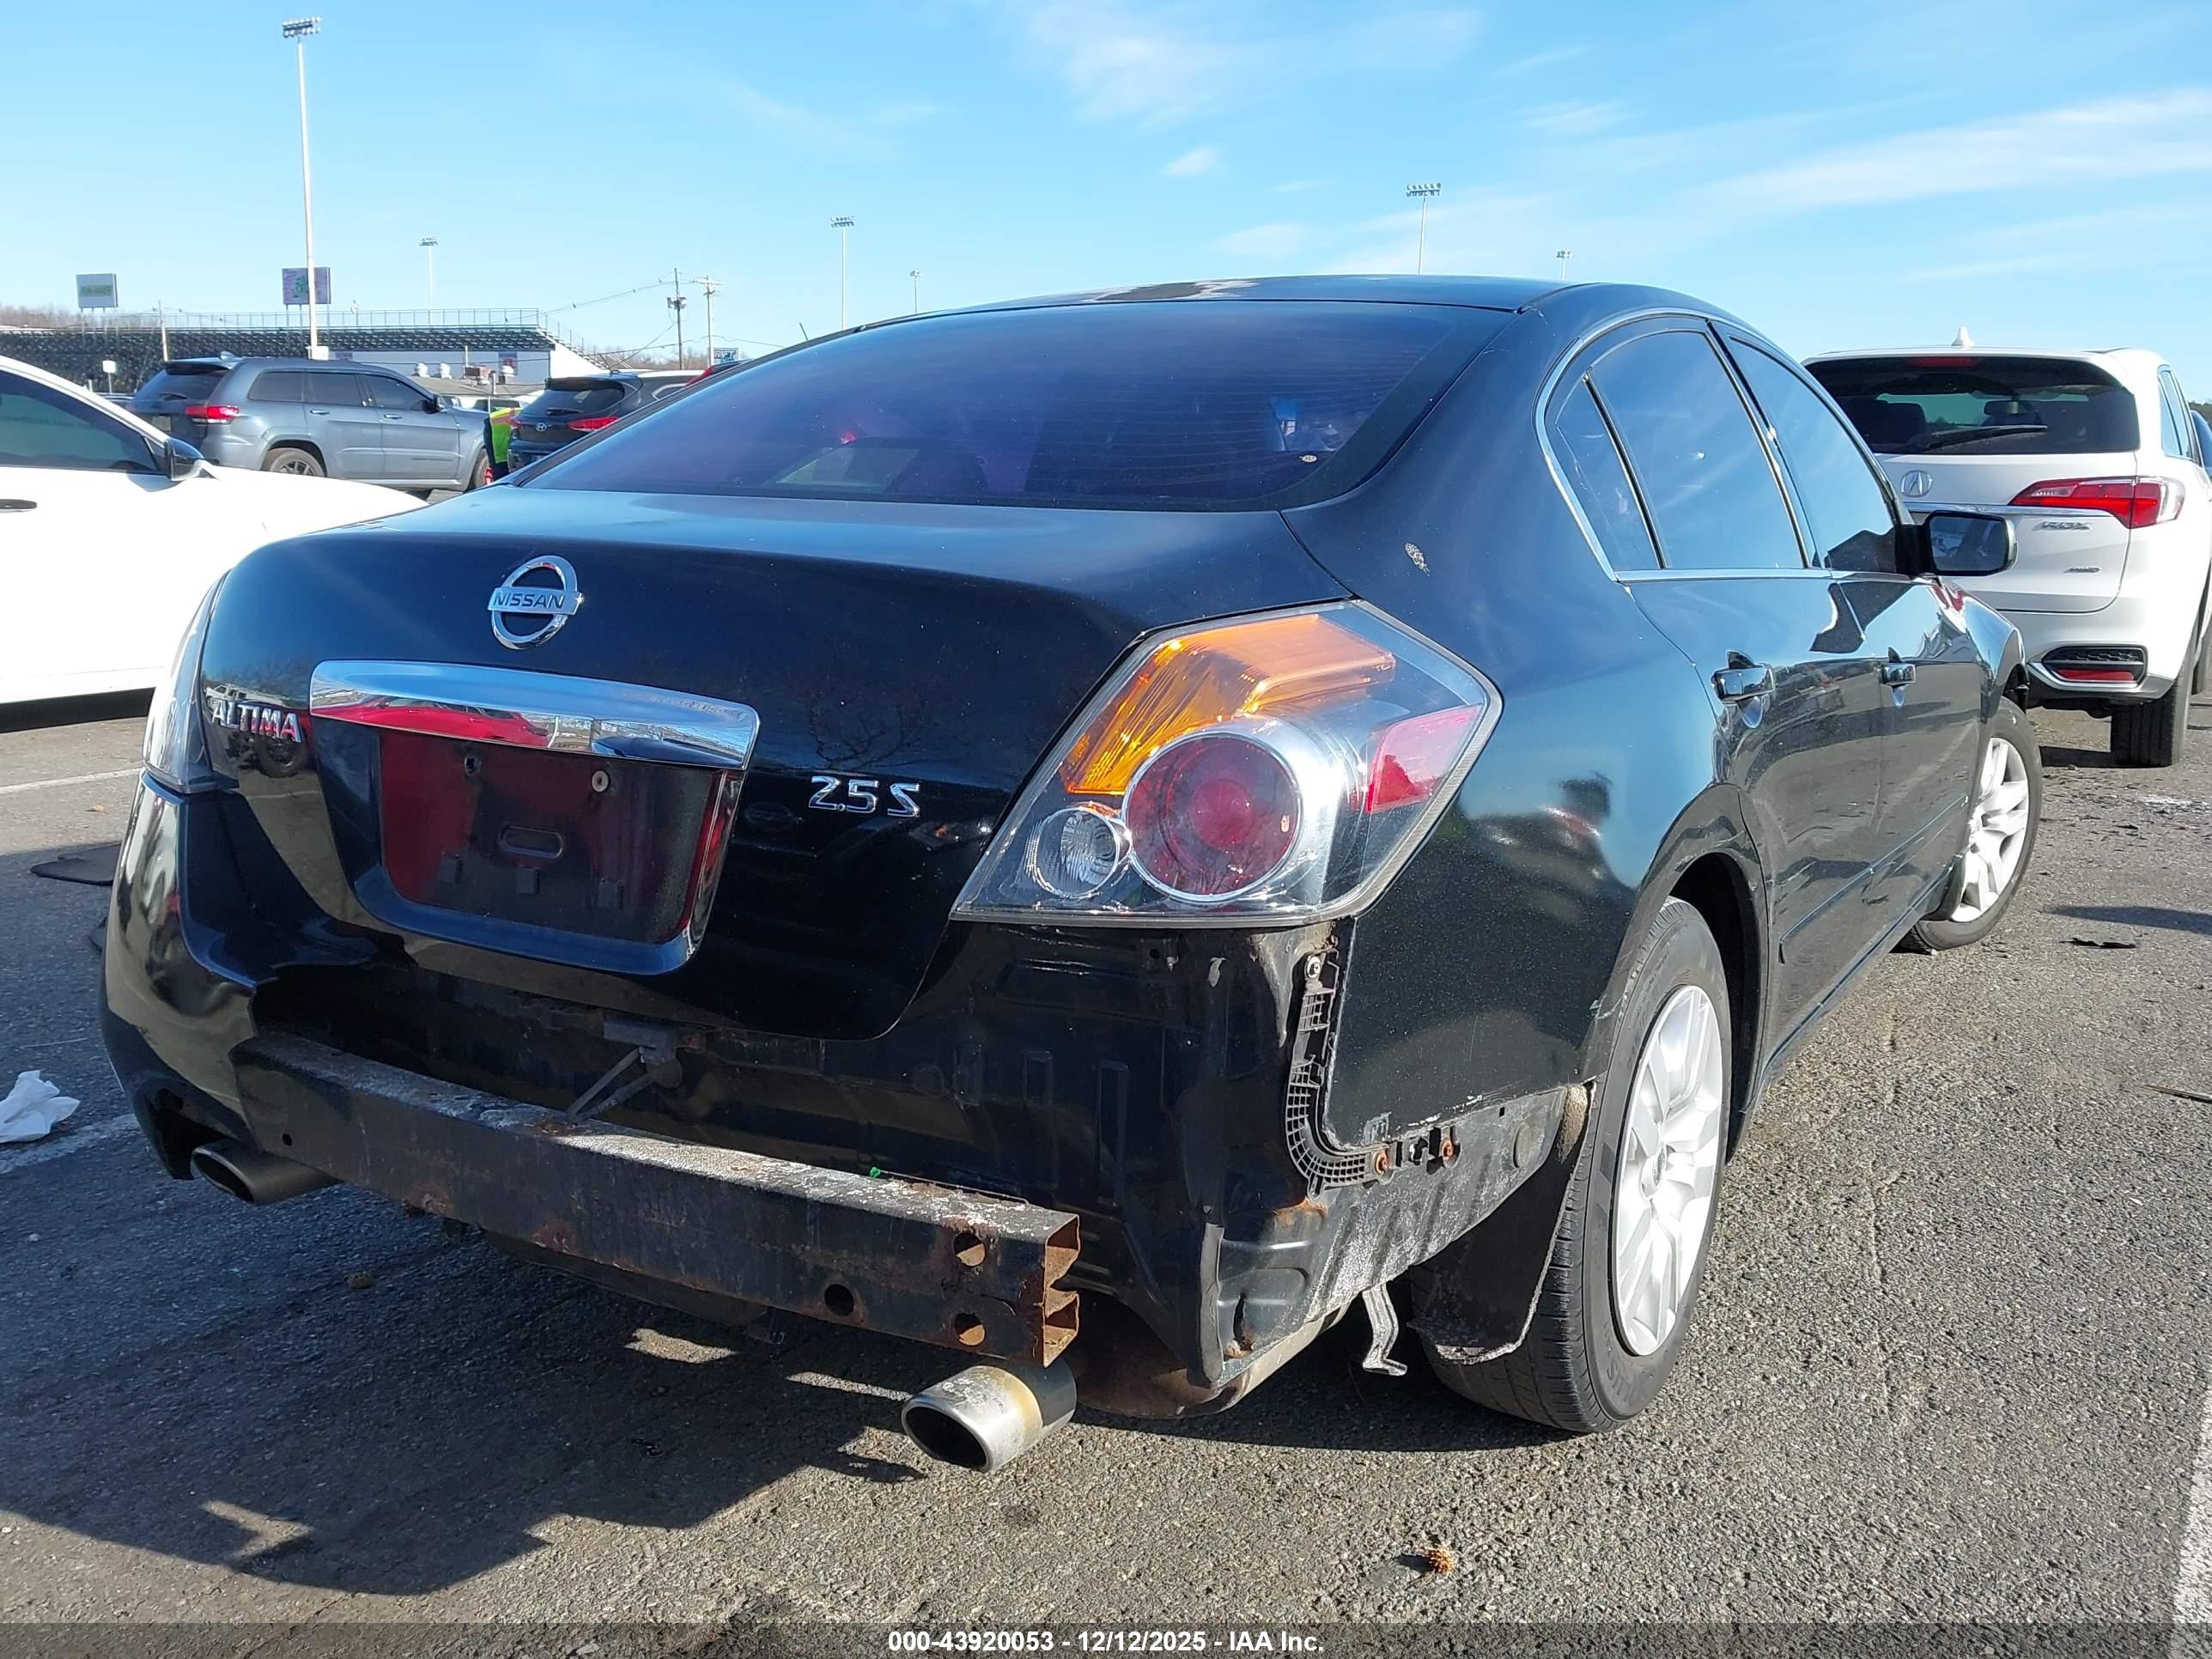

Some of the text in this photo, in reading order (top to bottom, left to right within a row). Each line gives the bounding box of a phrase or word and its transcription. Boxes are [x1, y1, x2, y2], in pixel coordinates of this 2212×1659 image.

[493, 592, 565, 610] NISSAN
[211, 700, 301, 743] ALTIMA
[808, 775, 921, 817] 2.5 S
